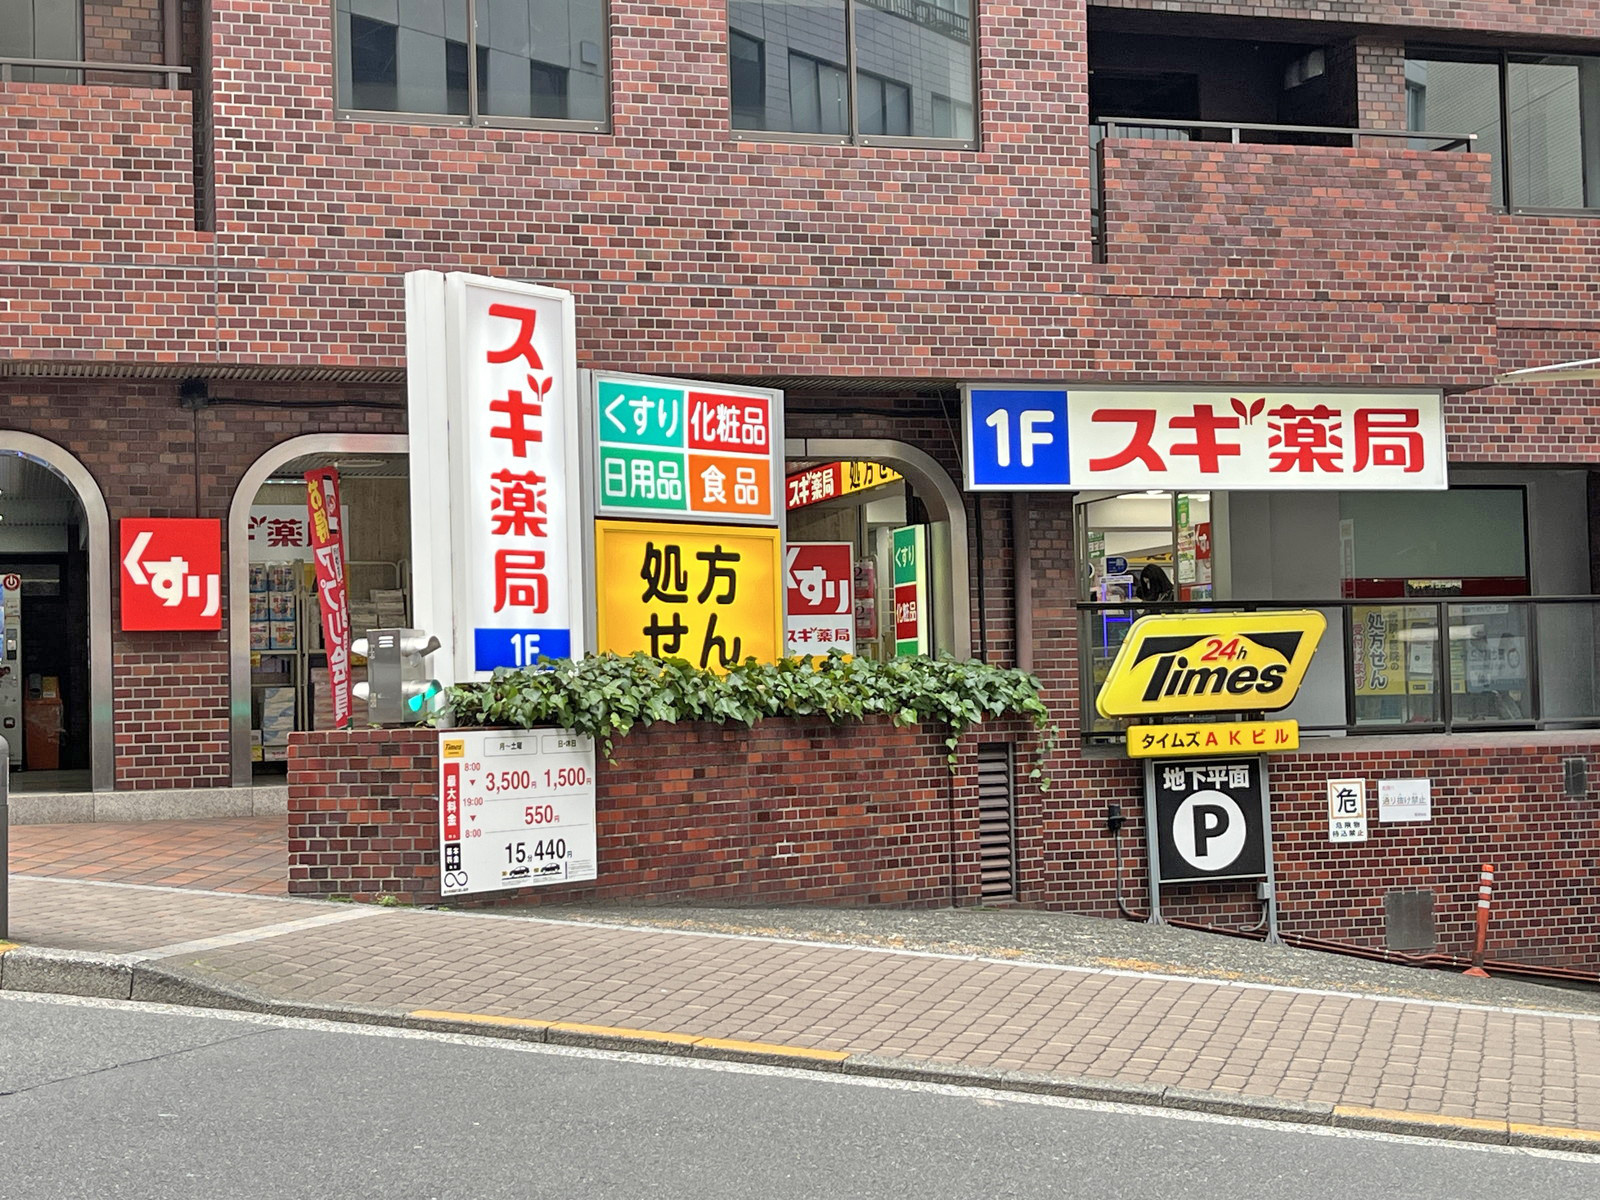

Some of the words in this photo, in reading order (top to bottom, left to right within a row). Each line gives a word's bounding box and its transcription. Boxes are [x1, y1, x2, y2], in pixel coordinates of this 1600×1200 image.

[604, 394, 679, 438] くすり
[690, 401, 766, 446] 化粧品
[985, 408, 1055, 468] 1F
[1088, 397, 1425, 474] スギ薬局
[486, 303, 553, 615] スギ薬局
[604, 457, 682, 501] 日用品
[700, 464, 760, 506] 食品
[789, 468, 834, 506] スギ薬局
[122, 532, 220, 617] くすり
[640, 541, 741, 605] 処方
[895, 545, 915, 568] くすり
[786, 547, 849, 613] くすり
[896, 601, 917, 624] 化粧品
[510, 633, 541, 666] 1F
[788, 627, 850, 643] スギ薬局
[1200, 638, 1247, 662] 24h
[1367, 611, 1387, 689] 処方せん
[1141, 656, 1287, 702] Times
[464, 762, 481, 771] 8:00
[485, 770, 537, 794] 3,500円
[544, 767, 592, 790] 1,500円
[1163, 766, 1250, 790] 地下平面
[463, 798, 484, 806] 19:00
[524, 804, 560, 825] 550円
[1337, 788, 1357, 813] 危
[465, 829, 482, 838] 8:00
[1192, 804, 1230, 857] P
